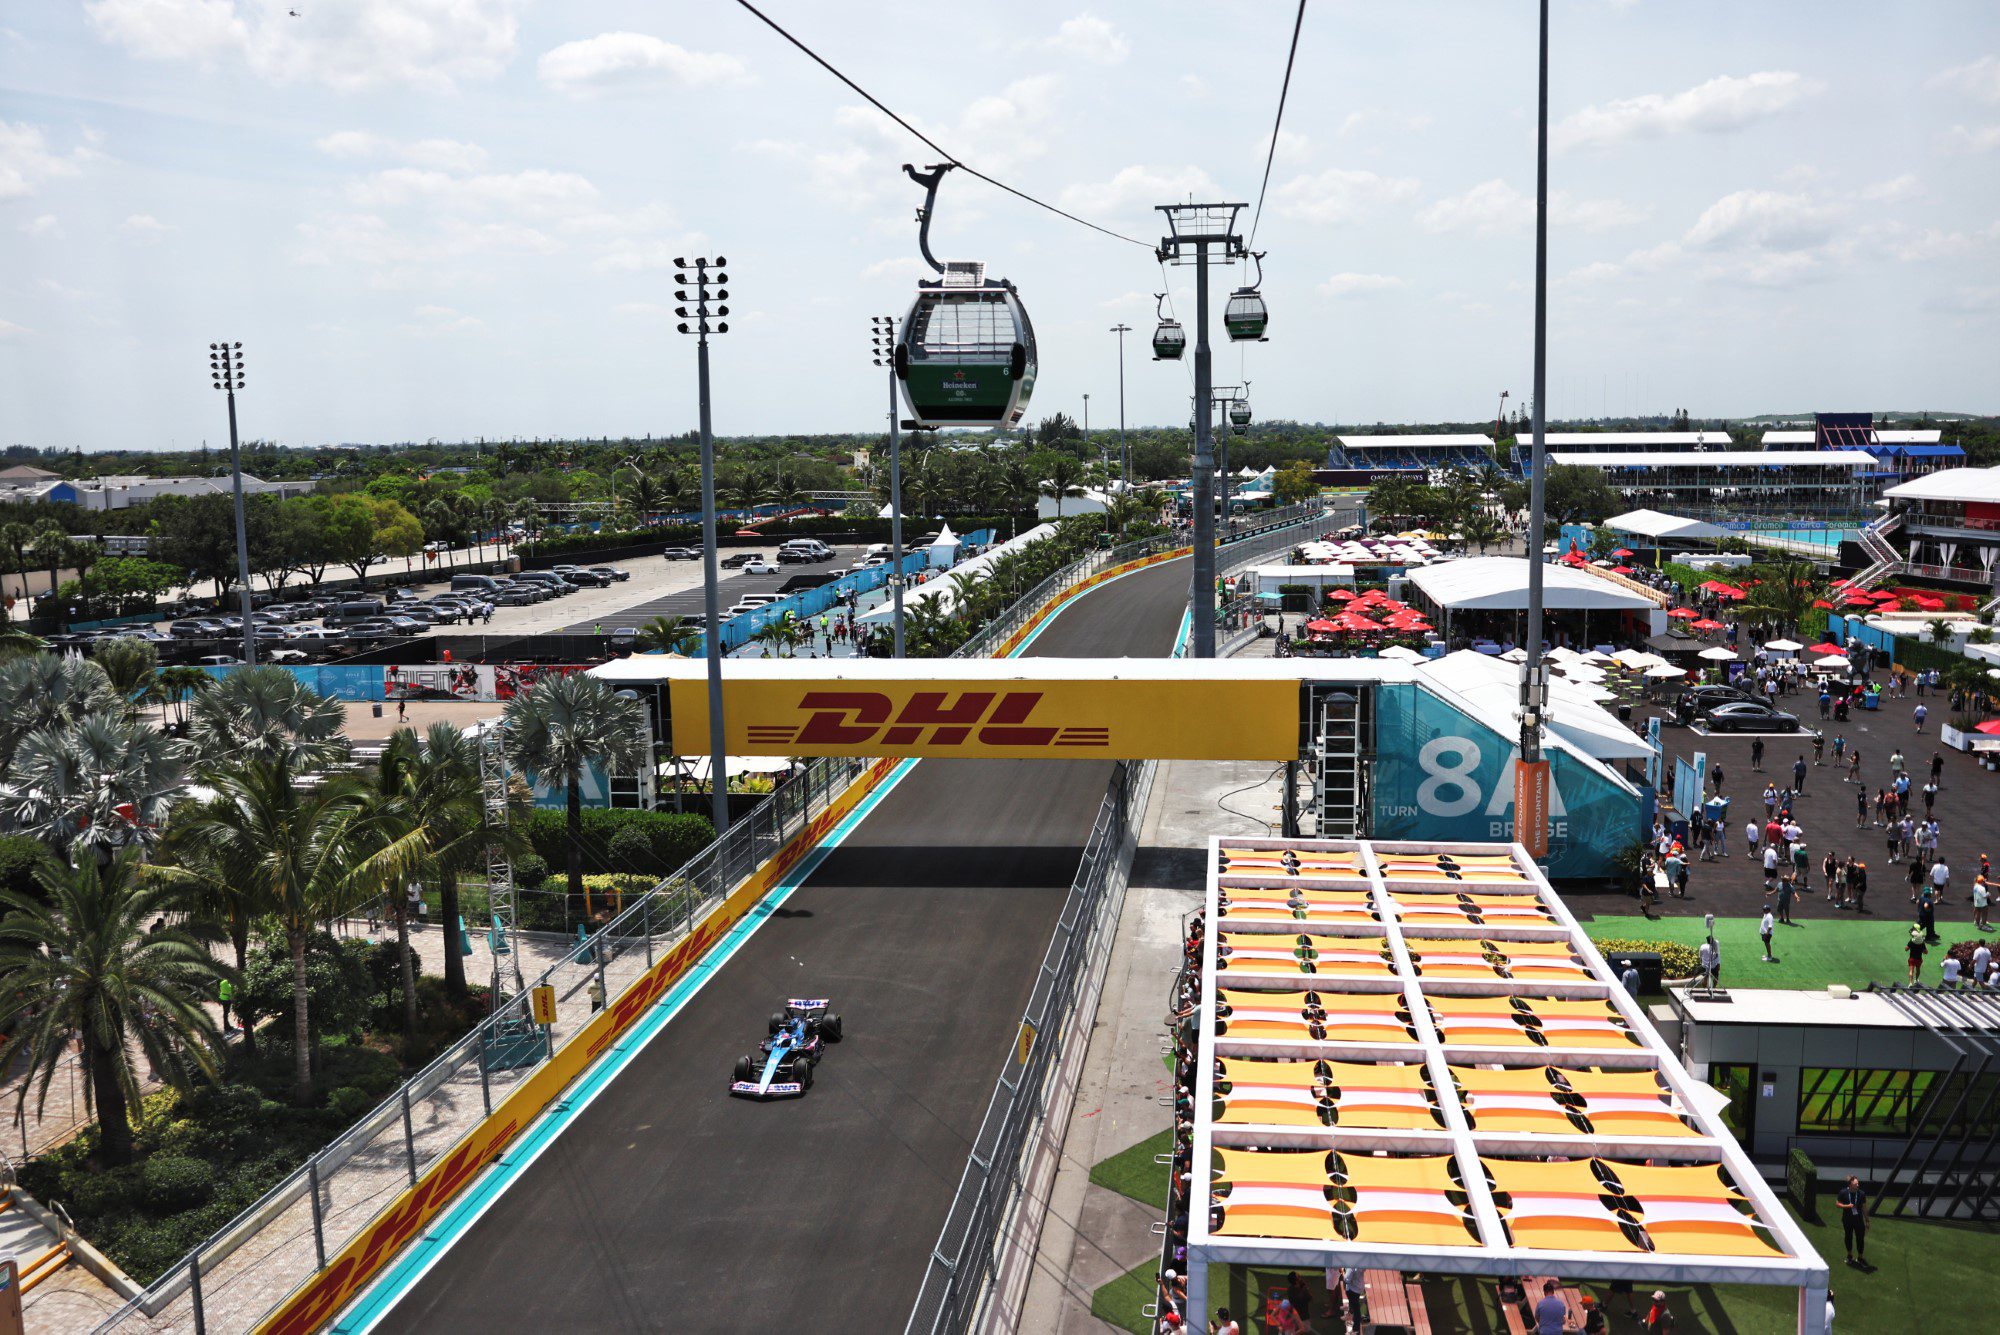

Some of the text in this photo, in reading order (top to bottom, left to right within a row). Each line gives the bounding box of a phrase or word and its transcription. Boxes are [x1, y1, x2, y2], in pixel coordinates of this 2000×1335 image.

[1754, 522, 1784, 530] aramco
[795, 692, 1061, 745] DHL
[1380, 805, 1418, 817] TURN
[1517, 769, 1525, 822] FOUNTAINS
[1533, 771, 1543, 850] THE FOUNTAINS
[777, 809, 834, 874] DHL
[1489, 821, 1568, 838] BRGE
[610, 923, 714, 1036] DHL
[267, 1140, 485, 1335] DHL
